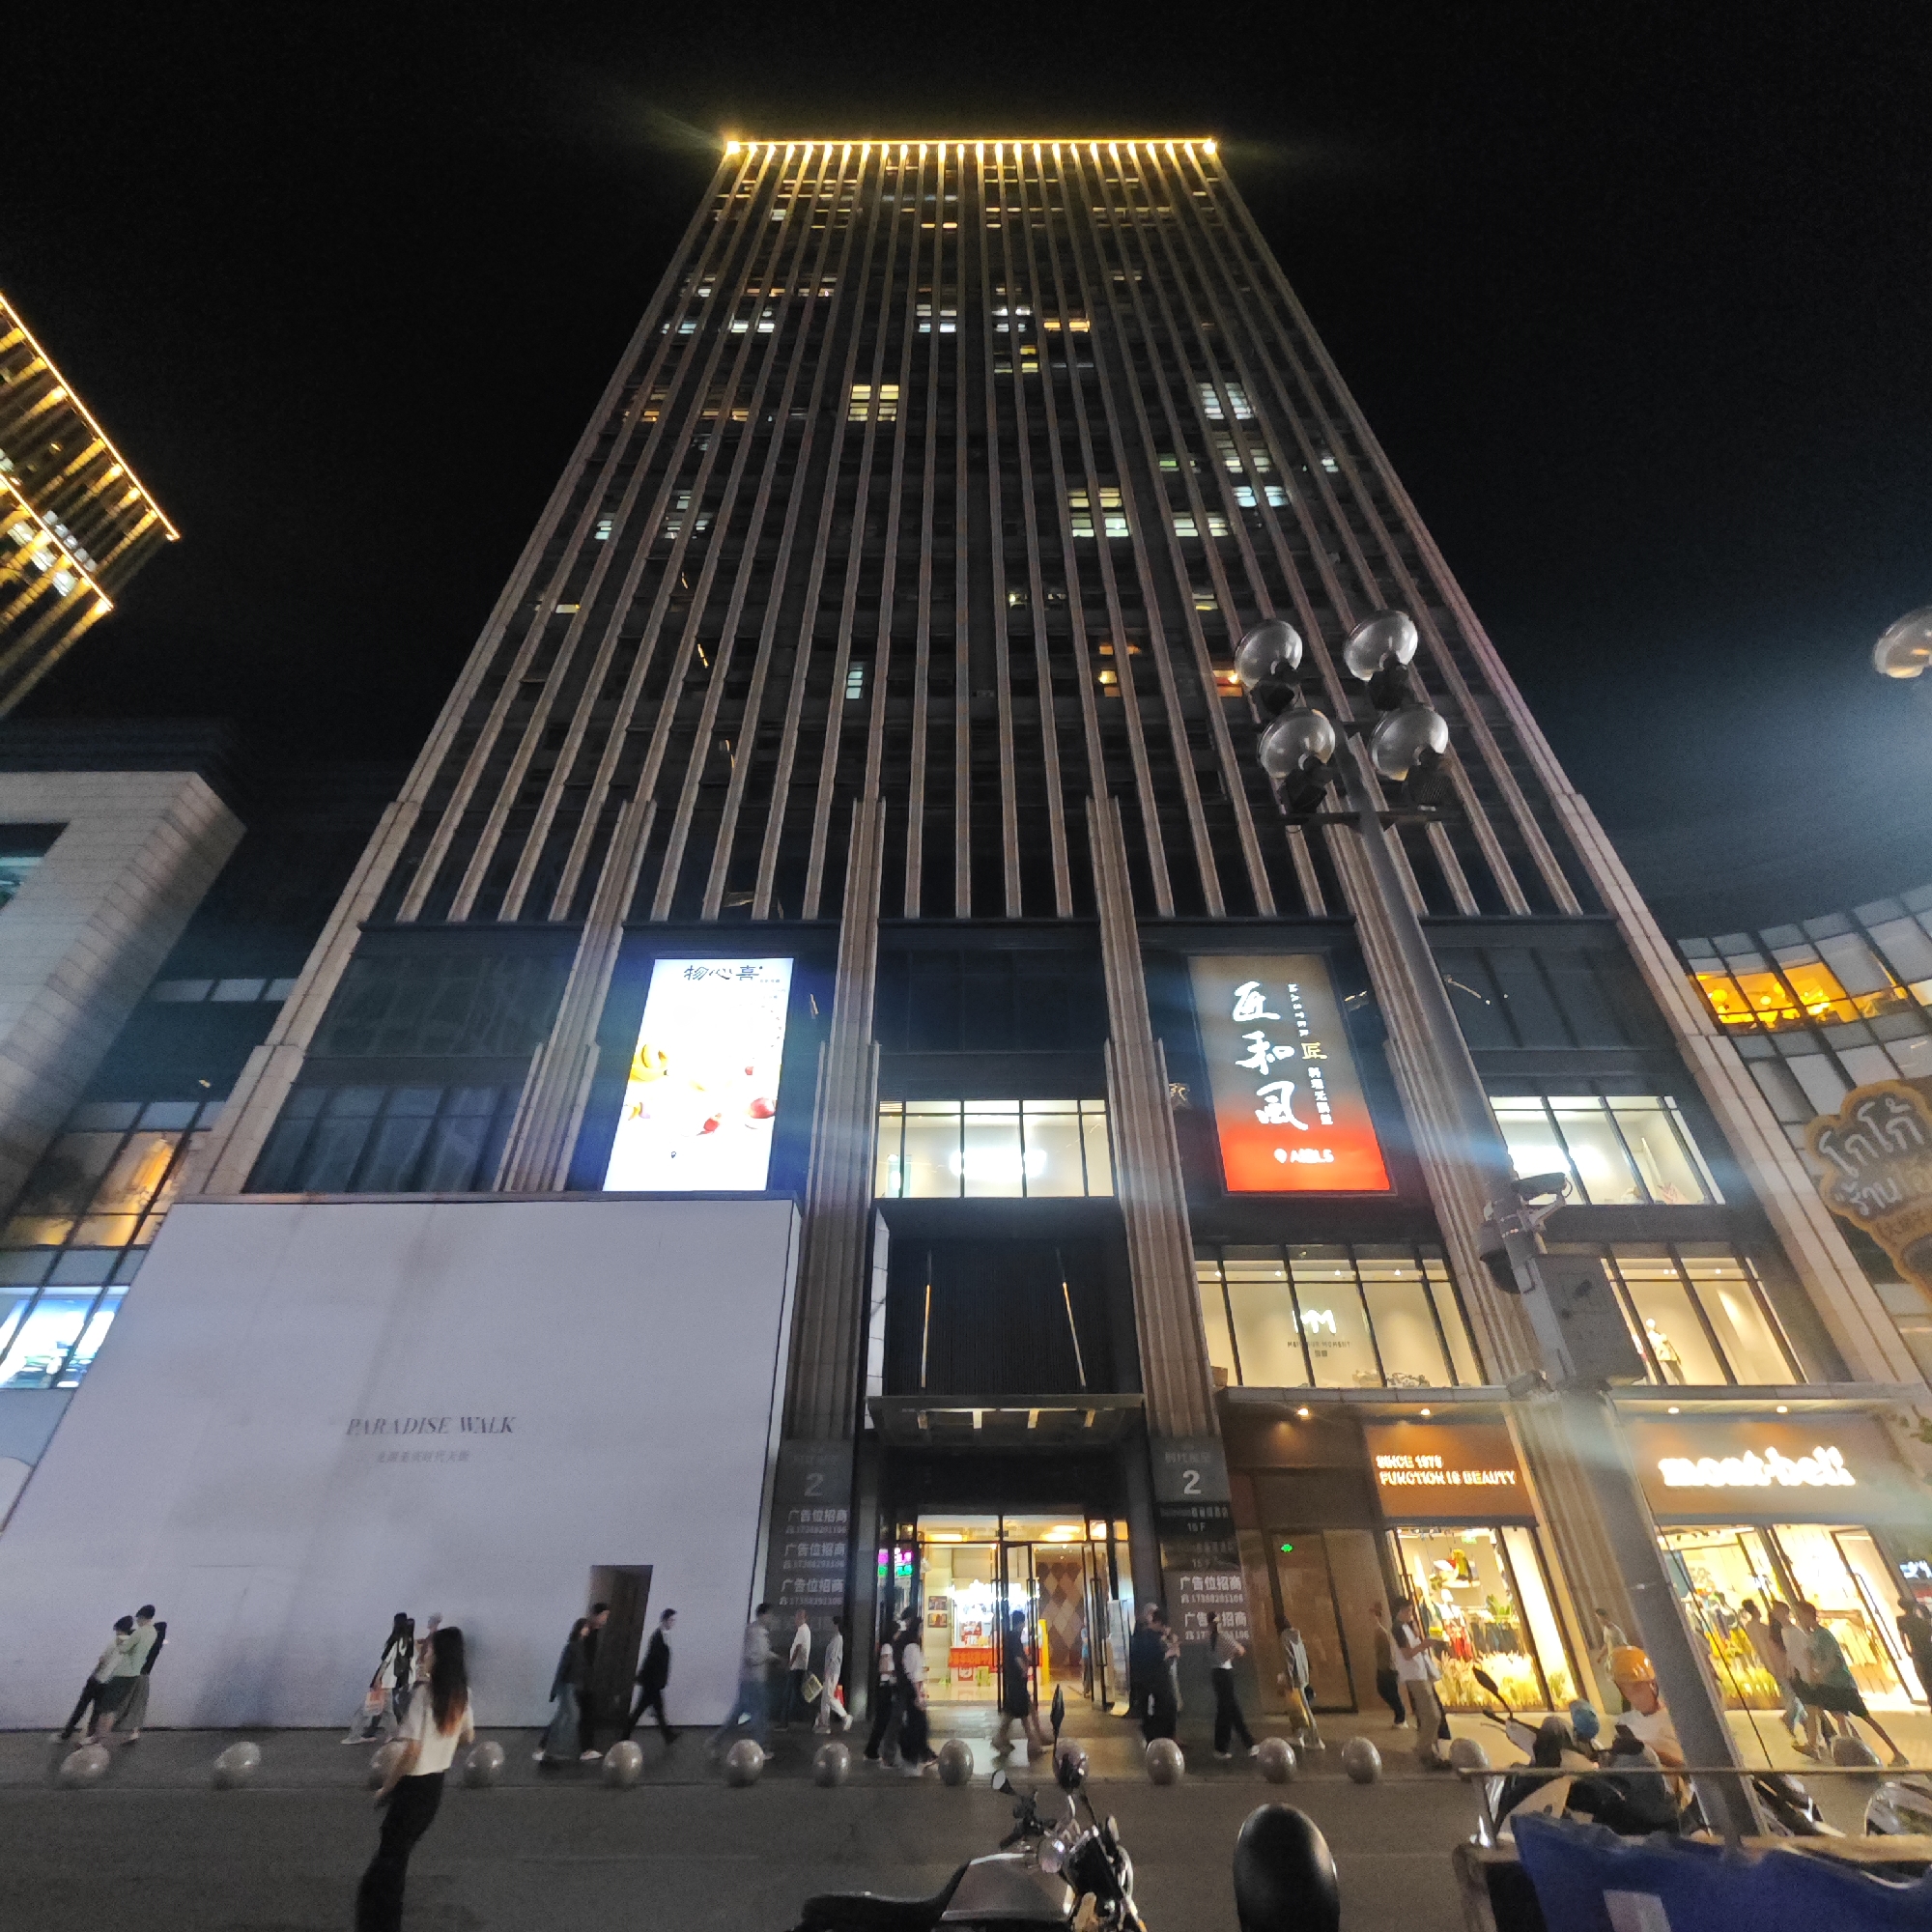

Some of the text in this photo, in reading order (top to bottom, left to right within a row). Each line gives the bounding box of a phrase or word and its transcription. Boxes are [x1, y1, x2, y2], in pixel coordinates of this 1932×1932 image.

[346, 1416, 517, 1435] PARADISE WALK
[1376, 1455, 1414, 1469] SINCE
[804, 1472, 824, 1496] 2
[1182, 1469, 1201, 1494] 2
[1379, 1470, 1517, 1486] FUNCTION IS BEAUTY
[787, 1509, 848, 1523] 广告位招商
[784, 1543, 845, 1557] 广告位招商
[781, 1577, 843, 1592] 广告位招商
[1179, 1576, 1242, 1591] 广告位招商
[1184, 1611, 1247, 1627] 广告招商
